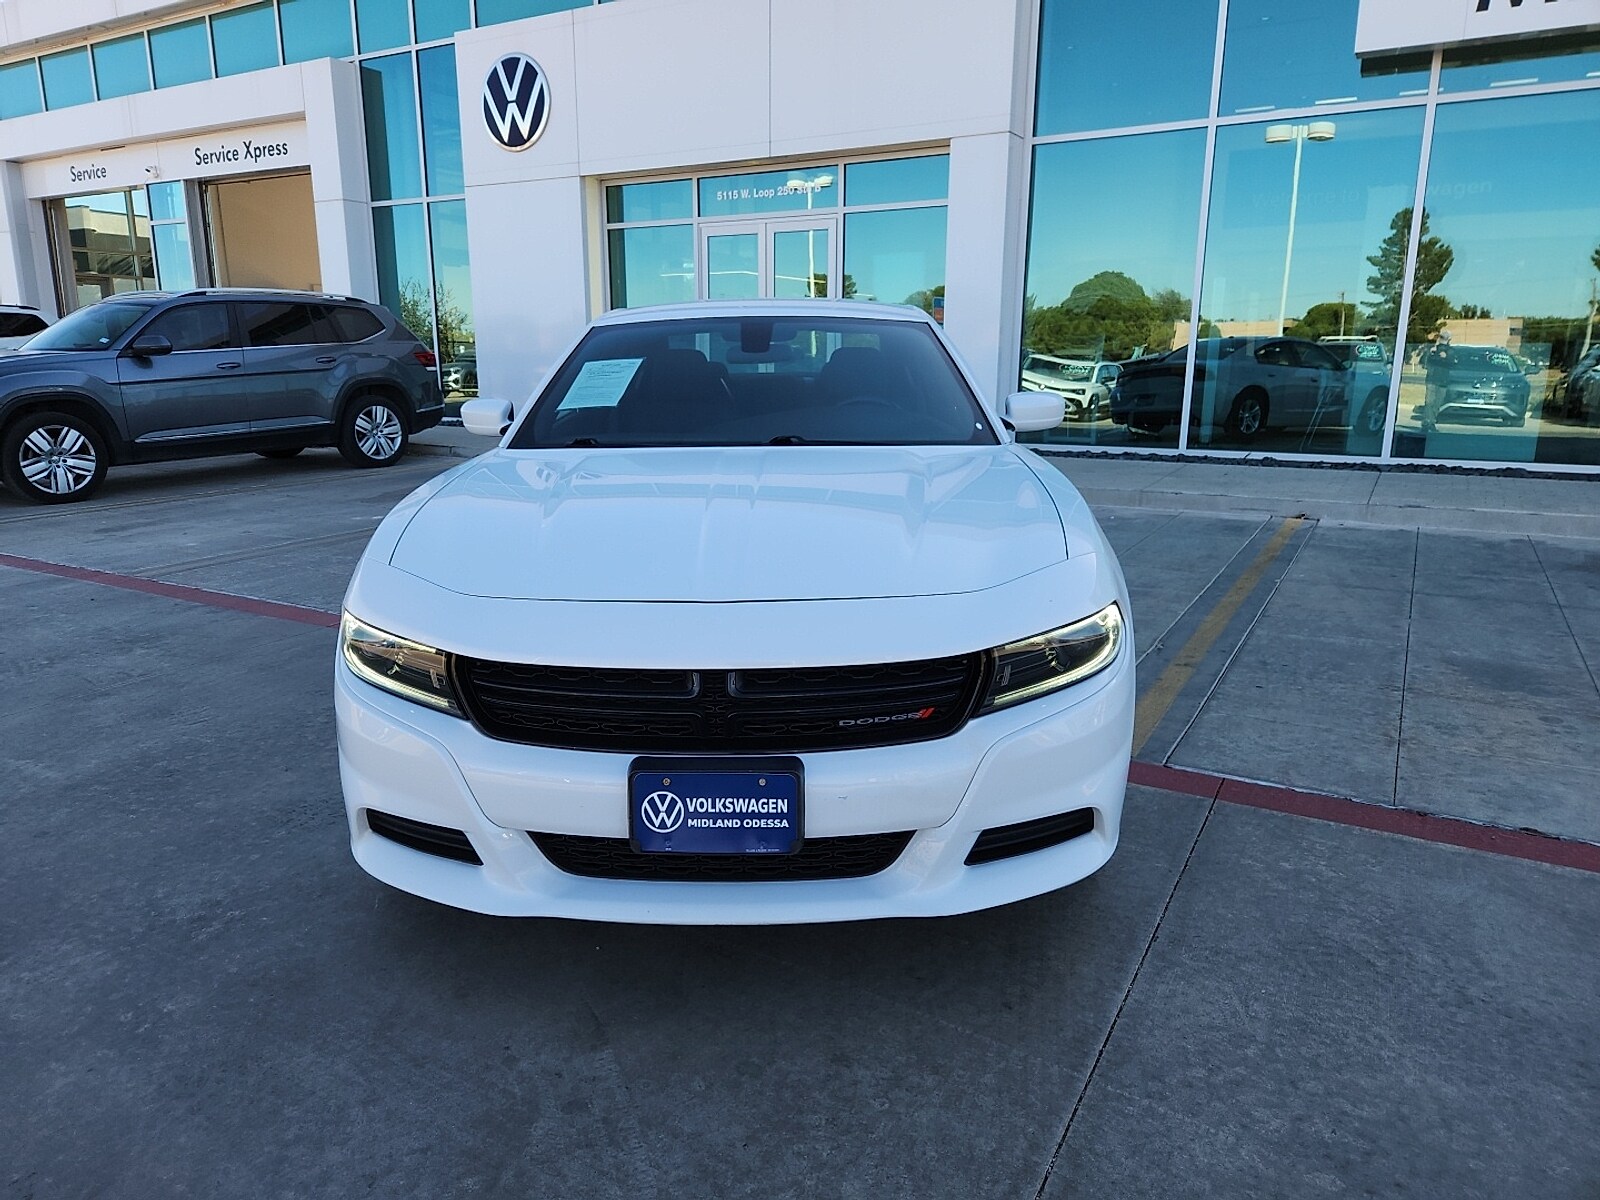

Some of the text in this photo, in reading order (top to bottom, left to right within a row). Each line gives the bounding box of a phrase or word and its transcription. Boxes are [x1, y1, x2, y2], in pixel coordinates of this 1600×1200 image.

[482, 55, 546, 144] VW
[194, 140, 289, 166] Service Xpress
[69, 164, 107, 182] Service
[716, 191, 739, 201] 5115
[741, 189, 751, 199] W.
[753, 188, 775, 199] Loop
[838, 712, 923, 726] DODGE
[686, 798, 788, 813] VOLKSWAGEN
[687, 819, 789, 828] MIDLAND ODESSA
